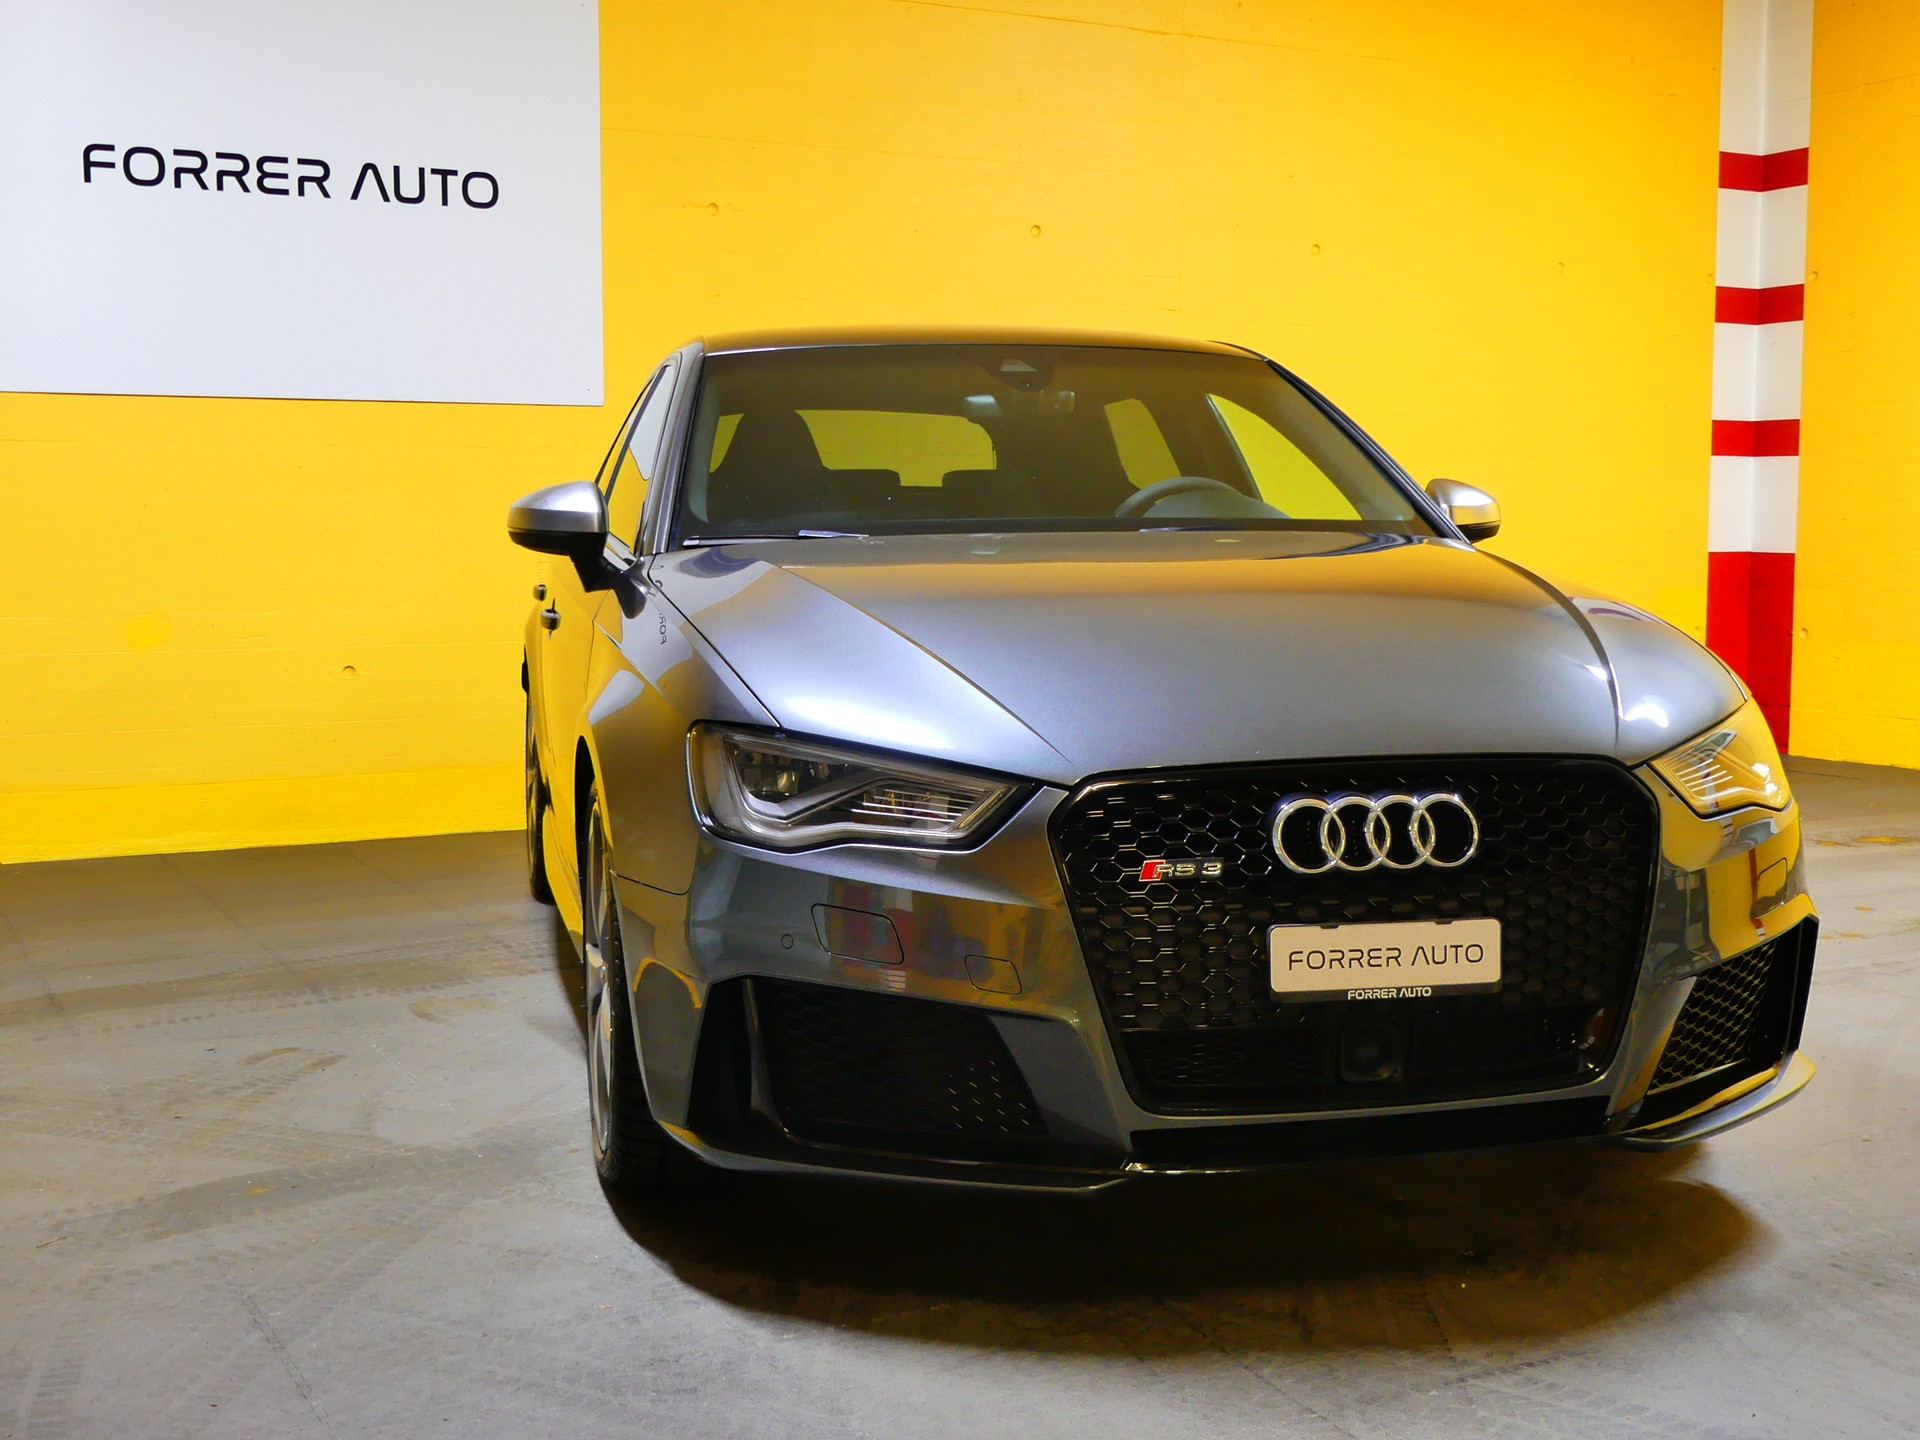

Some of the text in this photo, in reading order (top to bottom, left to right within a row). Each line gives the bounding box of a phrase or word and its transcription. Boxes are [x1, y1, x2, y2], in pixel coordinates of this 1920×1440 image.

[82, 143, 500, 210] FORRER AUTO
[1152, 862, 1222, 879] RS 3
[1288, 943, 1484, 971] FORRER AUTO
[1347, 986, 1432, 1000] FORRER AUTO
